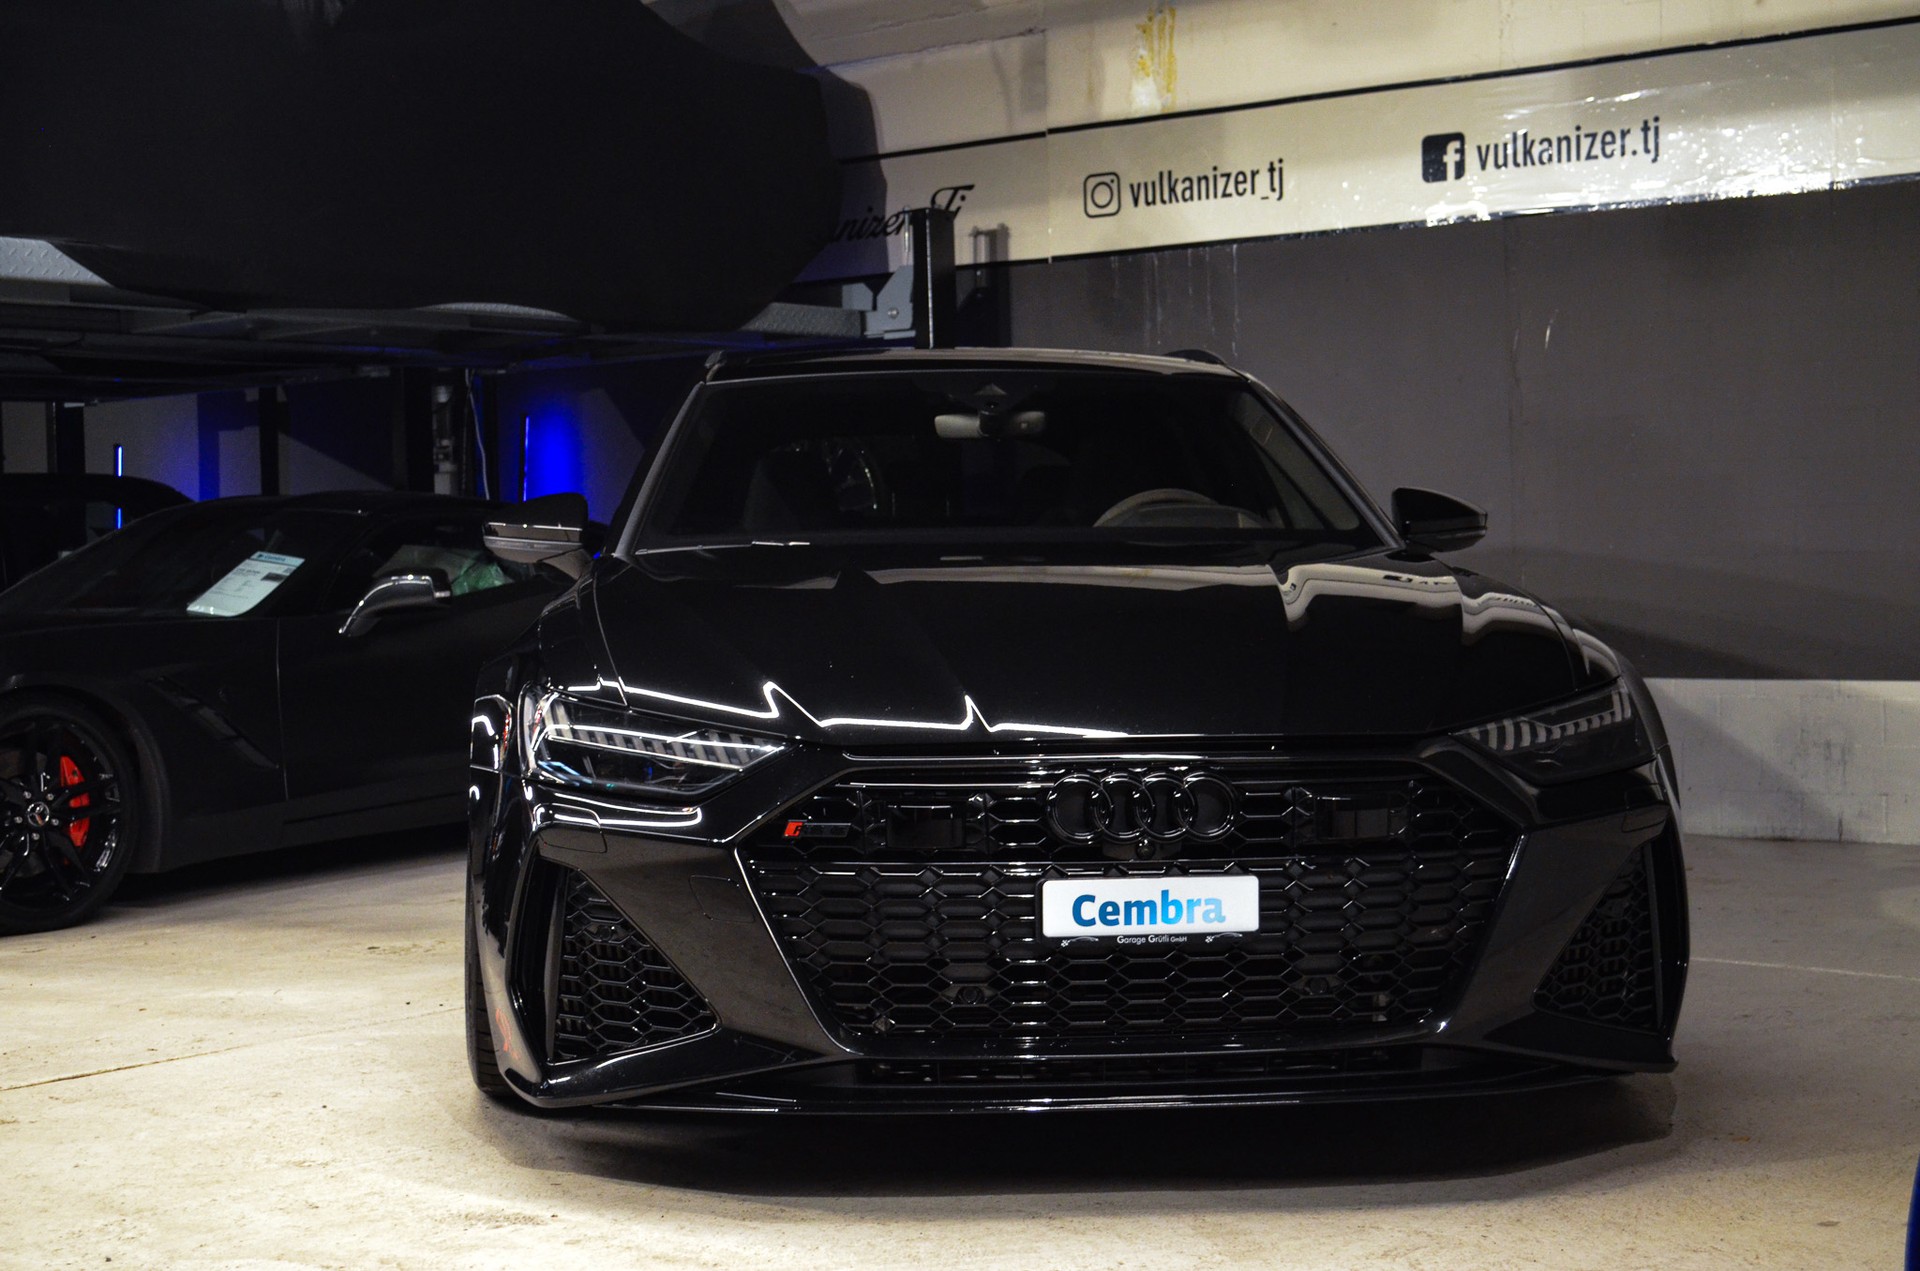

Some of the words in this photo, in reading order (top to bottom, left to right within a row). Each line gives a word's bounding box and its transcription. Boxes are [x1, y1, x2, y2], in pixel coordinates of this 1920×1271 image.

[1475, 116, 1661, 172] vulkanizer.tj
[1129, 157, 1284, 208] vulkanizer_tj
[1071, 889, 1227, 928] Cembra
[1116, 935, 1146, 946] Garage
